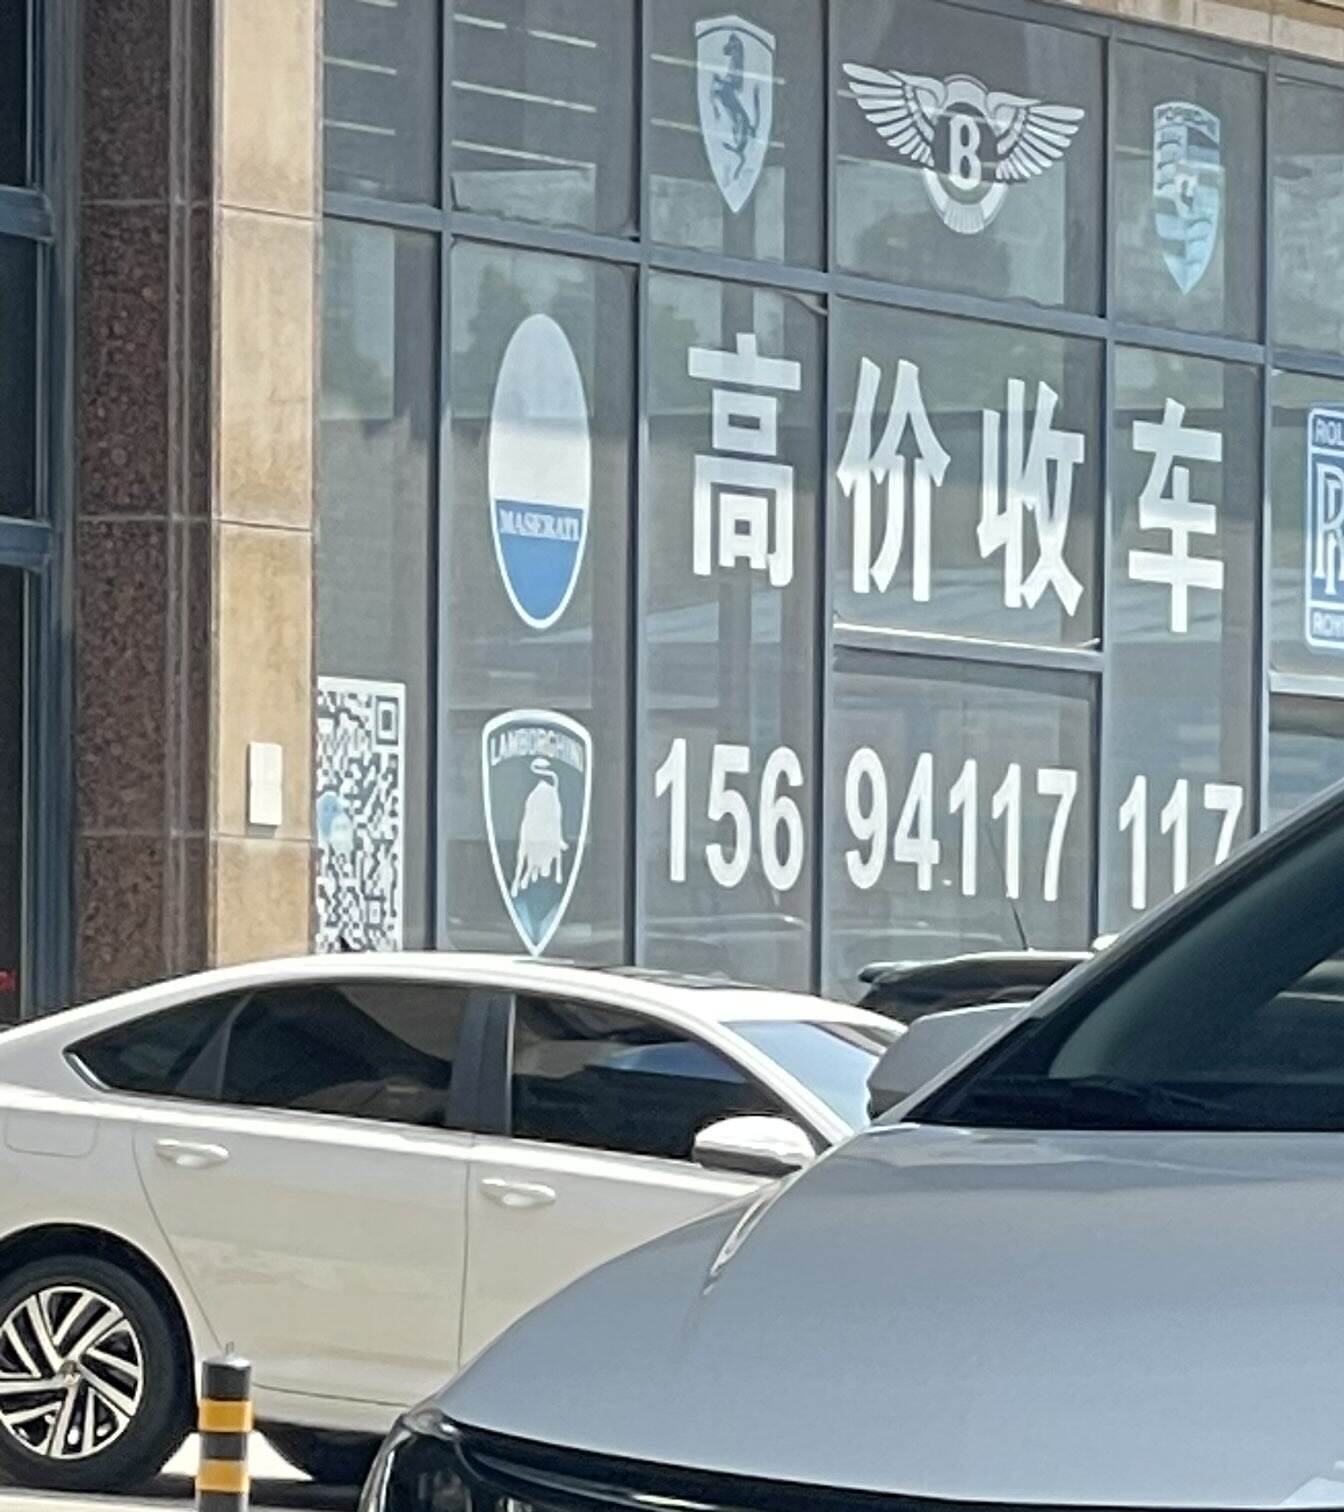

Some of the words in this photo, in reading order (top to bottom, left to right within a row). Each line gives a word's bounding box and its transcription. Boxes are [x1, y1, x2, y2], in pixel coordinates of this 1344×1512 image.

[687, 332, 1225, 634] 高价收车
[654, 737, 804, 892] 156
[844, 746, 1079, 902] 94117
[1118, 774, 1245, 911] 117
